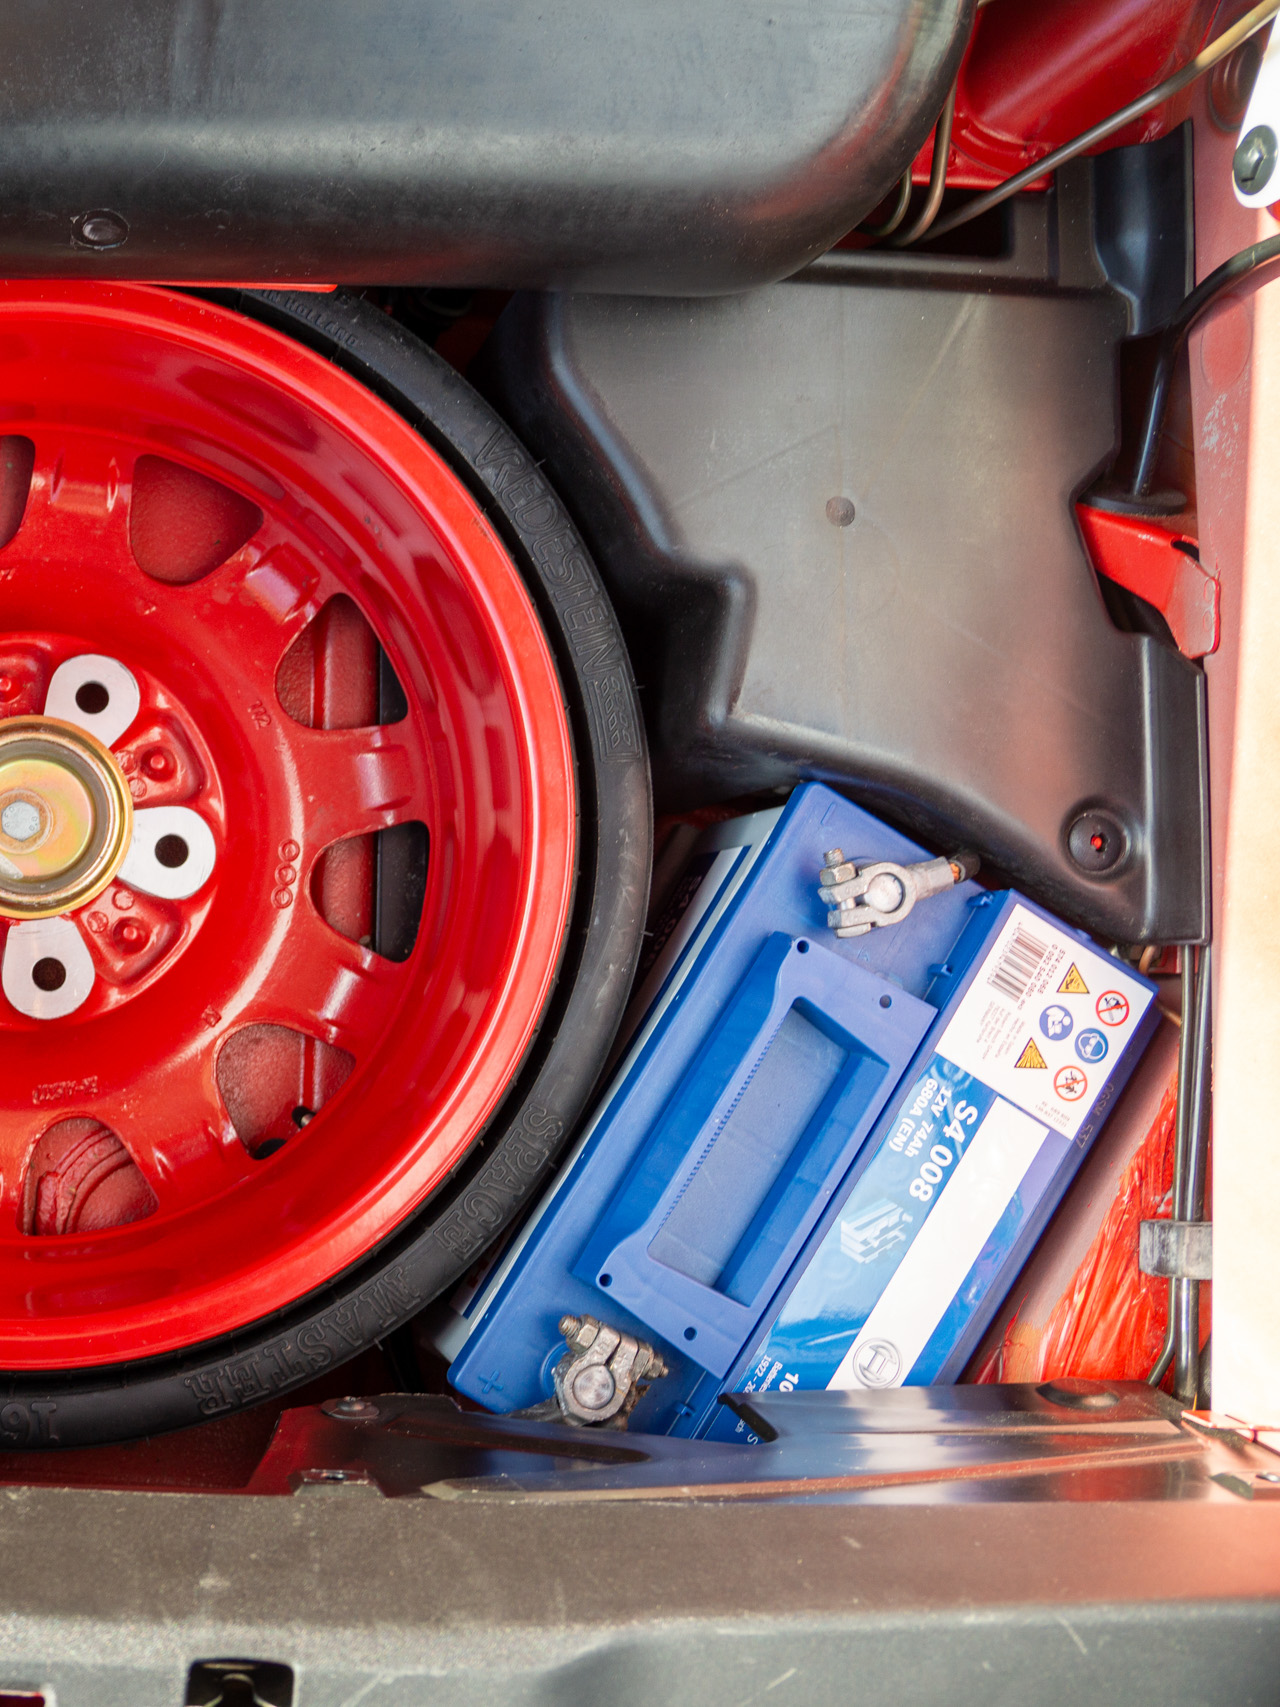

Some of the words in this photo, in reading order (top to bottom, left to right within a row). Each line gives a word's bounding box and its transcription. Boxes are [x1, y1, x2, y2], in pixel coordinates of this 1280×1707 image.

[472, 428, 624, 677] VREDESTEIN
[909, 1078, 938, 1118] 680A
[930, 1086, 952, 1118] 12V
[888, 1118, 915, 1152] (EN)
[905, 1122, 933, 1158] 74Ah
[943, 1099, 979, 1145] S4
[433, 1103, 565, 1257] SPACE
[909, 1143, 954, 1202] 008
[181, 1260, 426, 1422] MASTER
[755, 1354, 772, 1377] 1922
